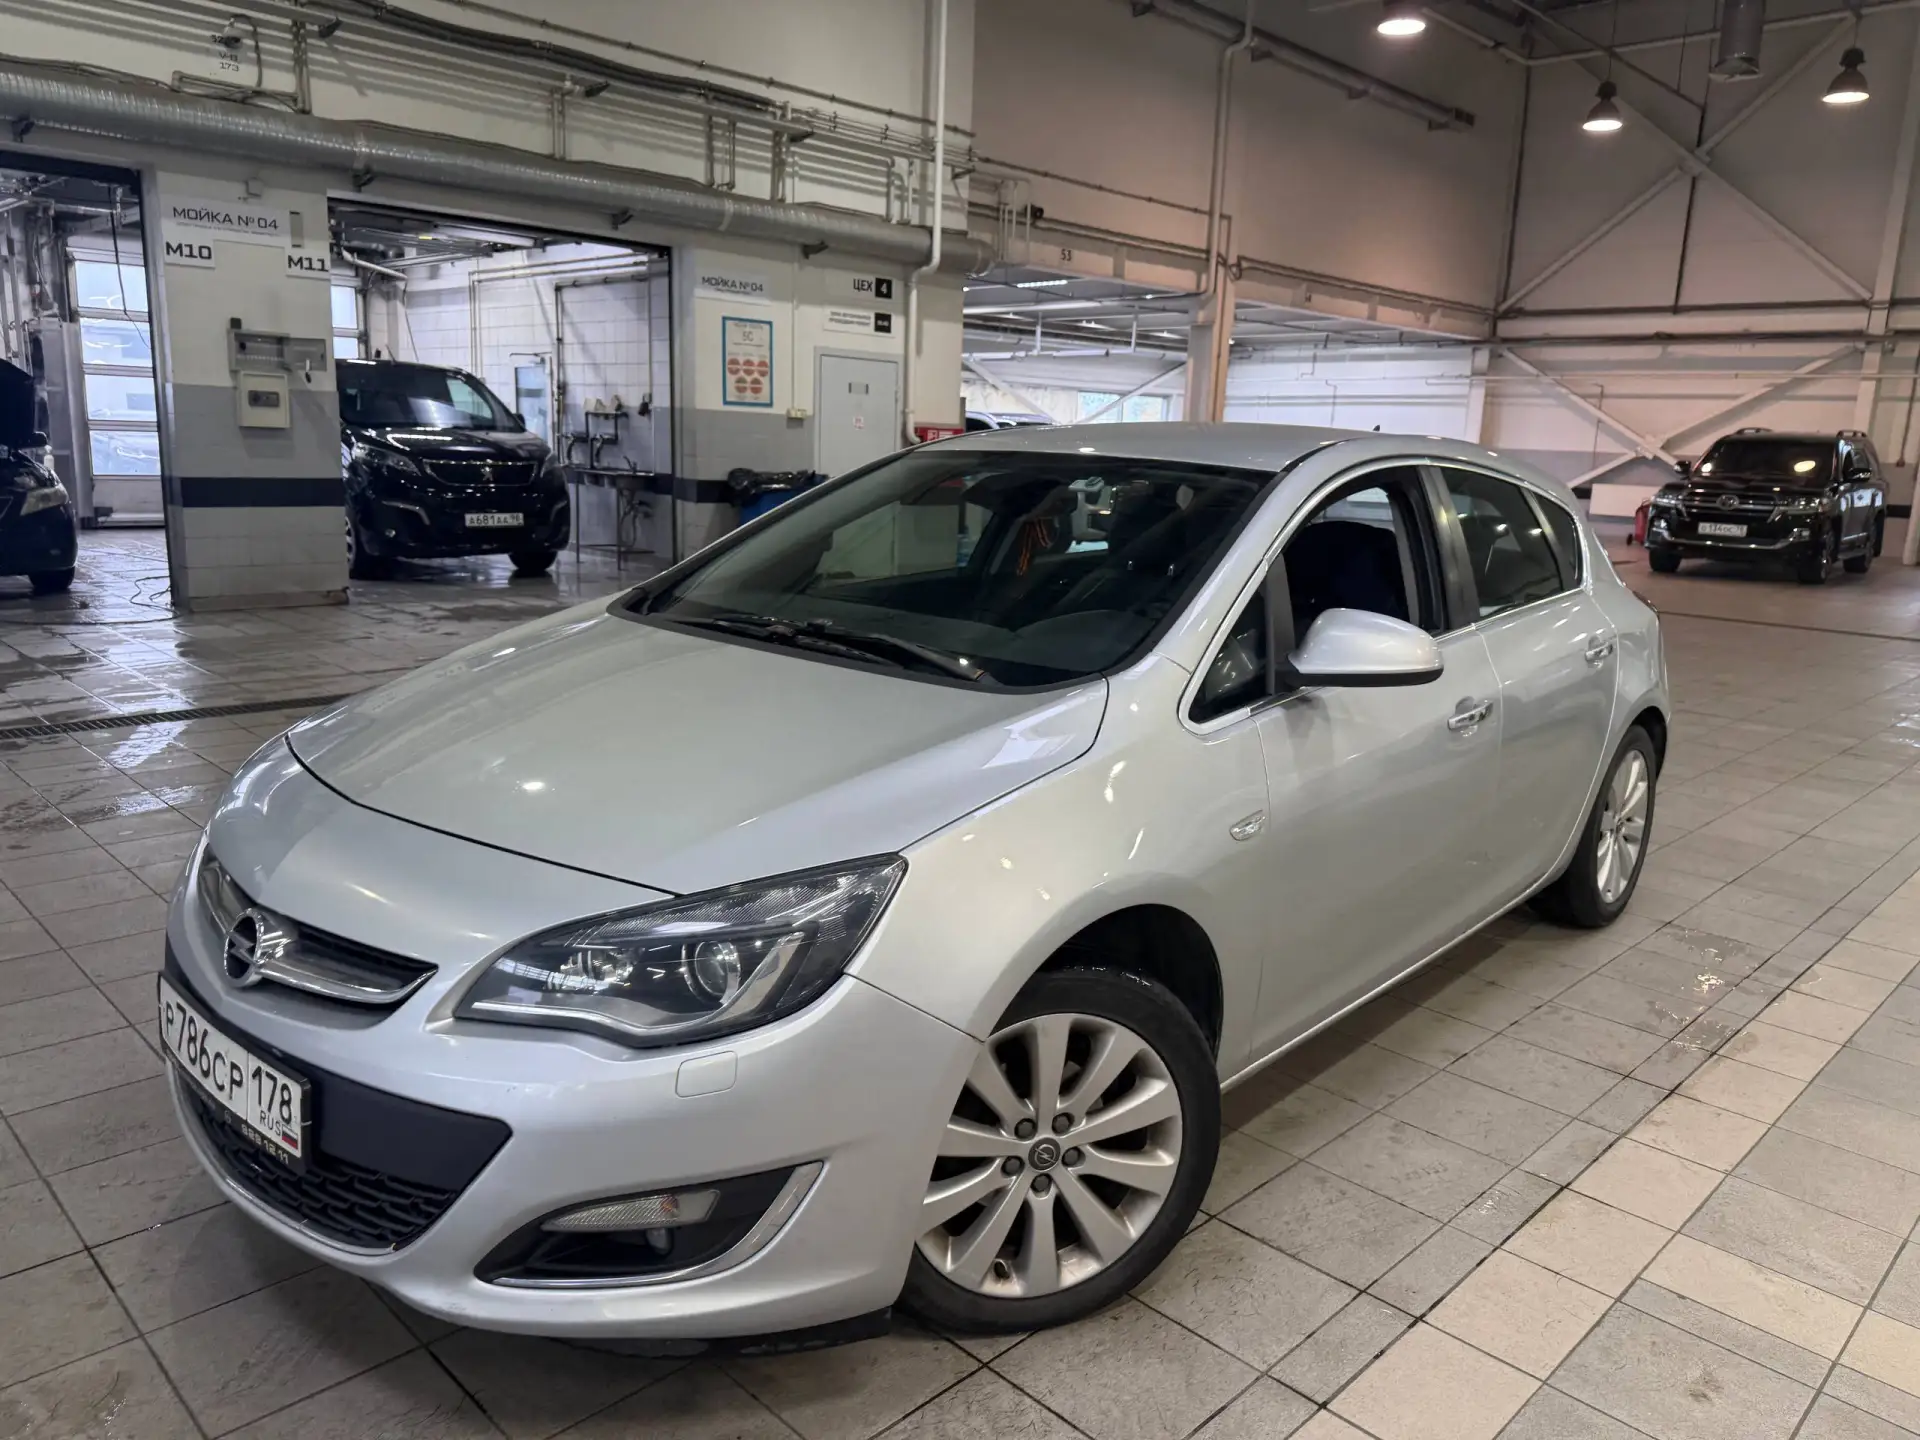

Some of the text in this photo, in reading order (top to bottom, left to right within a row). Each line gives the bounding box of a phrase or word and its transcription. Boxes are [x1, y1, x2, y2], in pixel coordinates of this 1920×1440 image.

[173, 206, 234, 225] МОЙКА
[258, 218, 279, 230] 04
[165, 241, 213, 260] М10
[1060, 248, 1072, 261] 53
[287, 255, 329, 272] М11
[702, 276, 737, 289] МОЙКА
[750, 282, 764, 292] 04
[853, 278, 888, 294] ЦЕХ 4
[165, 1001, 292, 1125] Р786СР 178
[259, 1110, 281, 1136] RUS
